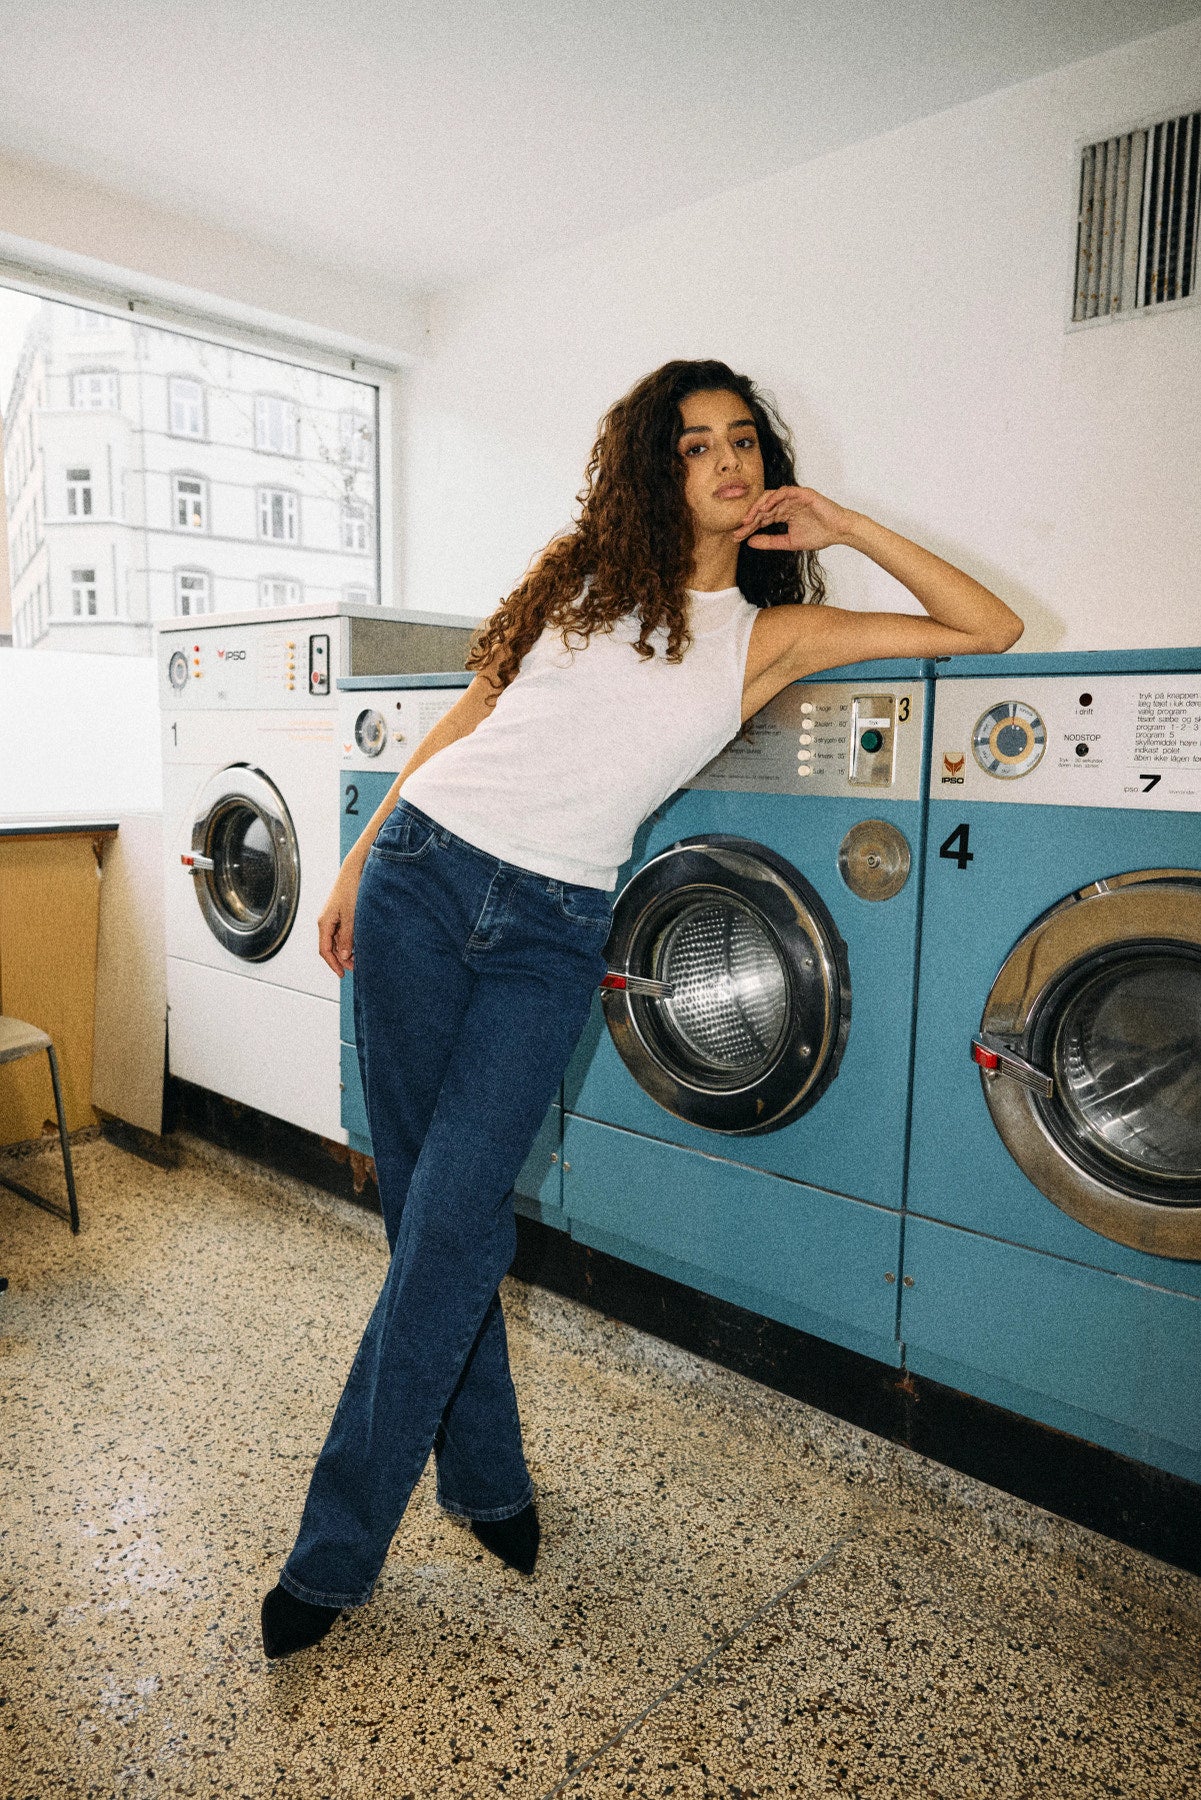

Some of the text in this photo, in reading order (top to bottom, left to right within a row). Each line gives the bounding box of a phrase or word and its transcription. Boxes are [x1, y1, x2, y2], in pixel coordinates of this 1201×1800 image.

[225, 650, 247, 661] IPSO
[1139, 692, 1198, 701] tryk på knappen
[898, 697, 910, 722] 3
[171, 722, 177, 747] 1
[1136, 724, 1165, 732] program
[941, 777, 964, 785] IPSO
[1139, 774, 1162, 793] 7
[345, 784, 359, 815] 2
[939, 823, 974, 870] 4
